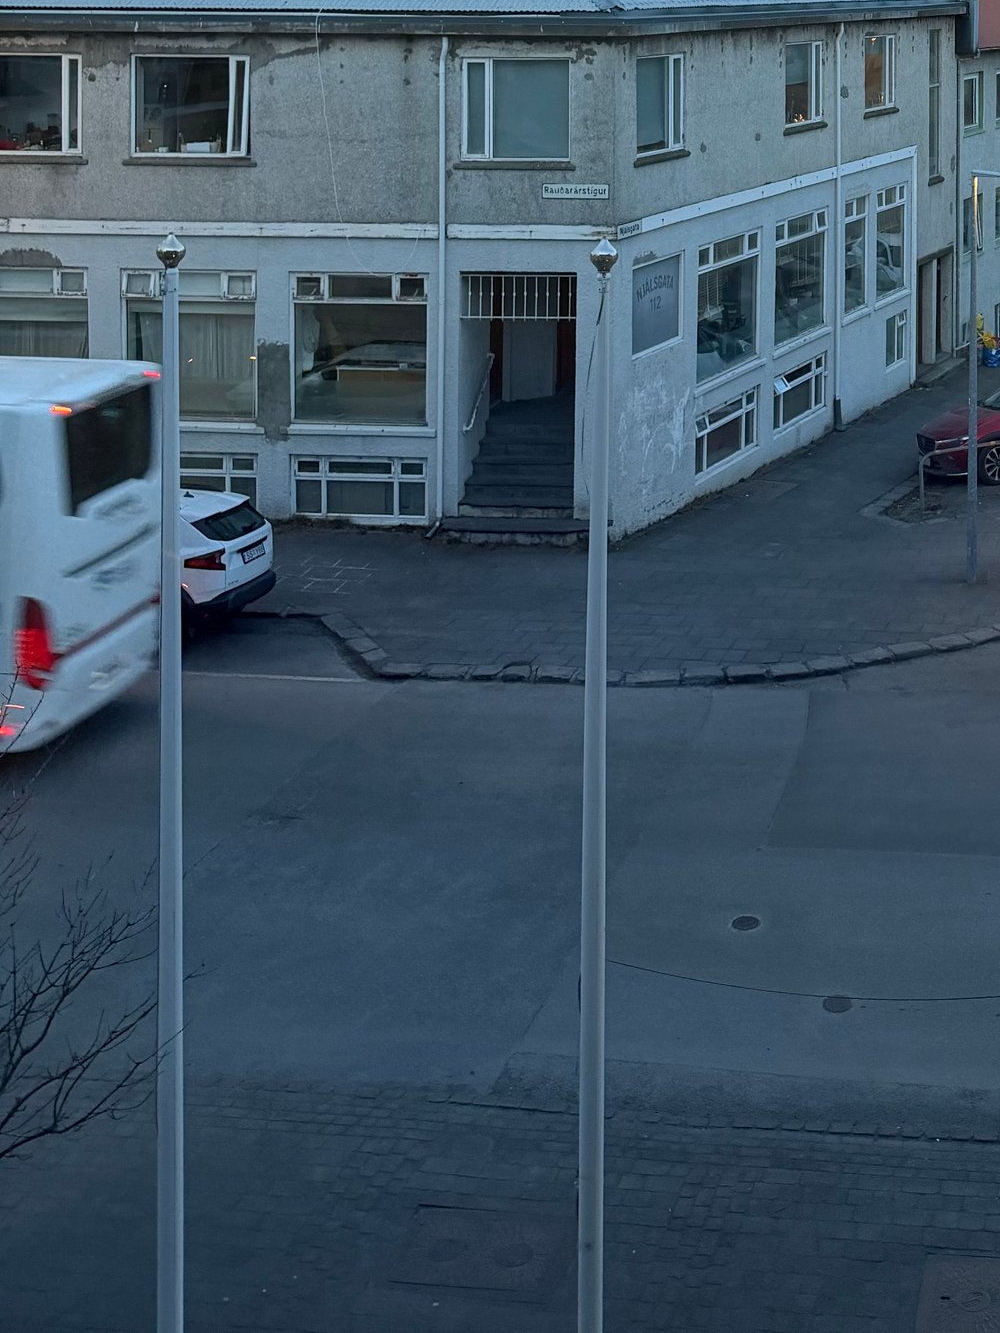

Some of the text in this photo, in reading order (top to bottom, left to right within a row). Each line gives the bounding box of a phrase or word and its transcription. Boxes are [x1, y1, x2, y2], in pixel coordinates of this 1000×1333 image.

[544, 186, 607, 196] Rauðarárstígur
[636, 274, 674, 303] NJÁLSGATA
[649, 296, 662, 311] 112
